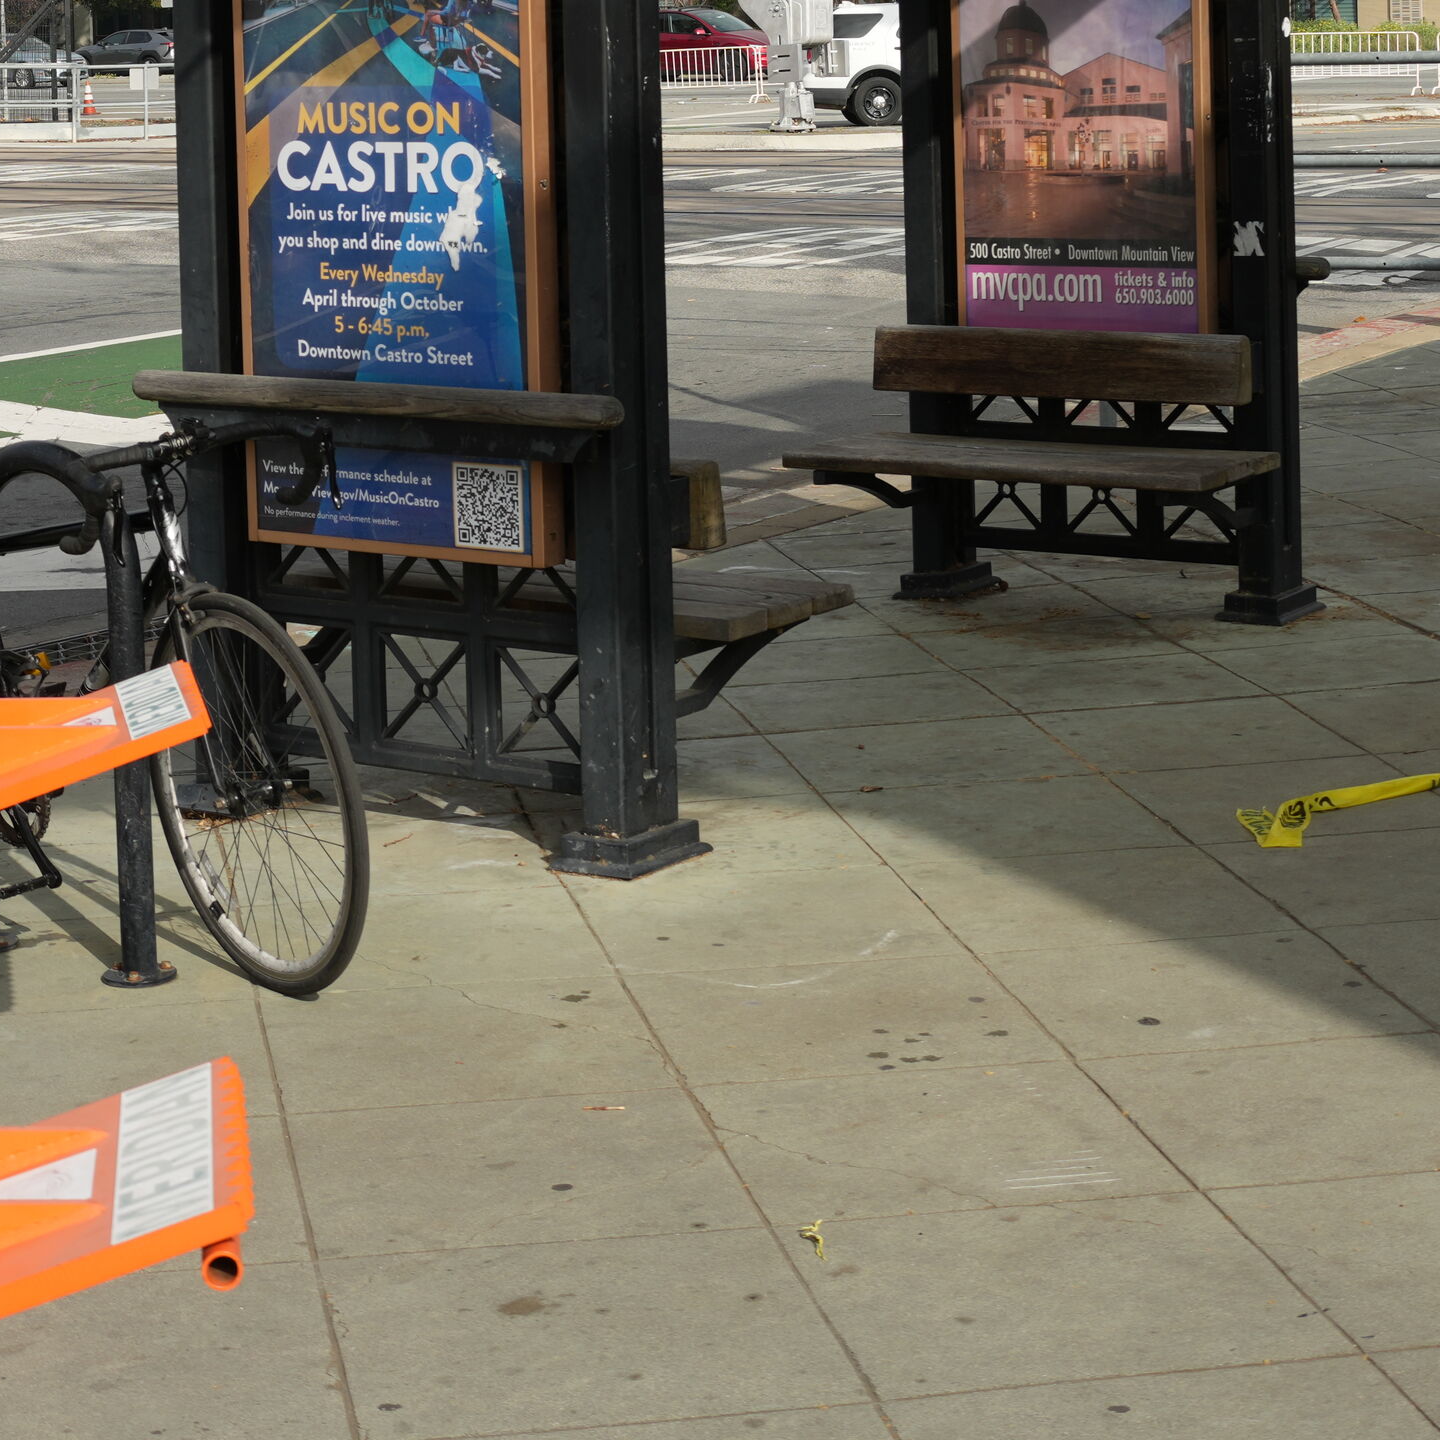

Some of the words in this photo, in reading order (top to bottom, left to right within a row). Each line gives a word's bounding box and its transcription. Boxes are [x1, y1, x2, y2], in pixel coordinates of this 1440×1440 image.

[297, 102, 400, 134] MUSIC
[407, 102, 460, 134] ON
[277, 140, 484, 194] CASTRO
[287, 203, 315, 221] Join
[319, 208, 333, 221] us
[337, 204, 358, 222] for
[362, 205, 386, 222] live
[391, 206, 432, 224] music
[278, 235, 303, 255] you
[307, 231, 338, 255] shop
[342, 233, 367, 251] and
[371, 234, 402, 252] dine
[406, 234, 488, 254] downwn.
[970, 243, 989, 259] 500
[991, 243, 1021, 259] Castro
[1024, 243, 1051, 260] Street
[1068, 244, 1119, 261] Downtown
[1121, 245, 1168, 262] Mountain
[1171, 246, 1194, 262] View
[320, 262, 358, 287] Every
[362, 264, 444, 289] Wednesday
[1114, 271, 1153, 287] tickets
[1157, 272, 1167, 287] &
[1171, 272, 1194, 288] info
[302, 288, 337, 311] April
[341, 289, 396, 315] through
[400, 292, 463, 312] October
[972, 271, 1103, 311] mvcpa.com
[1115, 289, 1194, 305] 650.903.6000
[334, 316, 344, 333] 5
[358, 318, 392, 335] 6:45
[298, 339, 371, 361] Downtown
[375, 344, 423, 363] Castro
[427, 346, 473, 366] Street
[263, 460, 286, 474] View
[289, 462, 304, 475] the
[310, 464, 371, 481] frmance
[374, 470, 419, 485] schedule
[421, 475, 432, 486] at
[264, 506, 274, 515] No
[276, 507, 316, 519] performance
[317, 511, 338, 524] during
[339, 513, 371, 524] inclement
[372, 515, 400, 527] weather.
[116, 1067, 210, 1242] MERIDIAN
